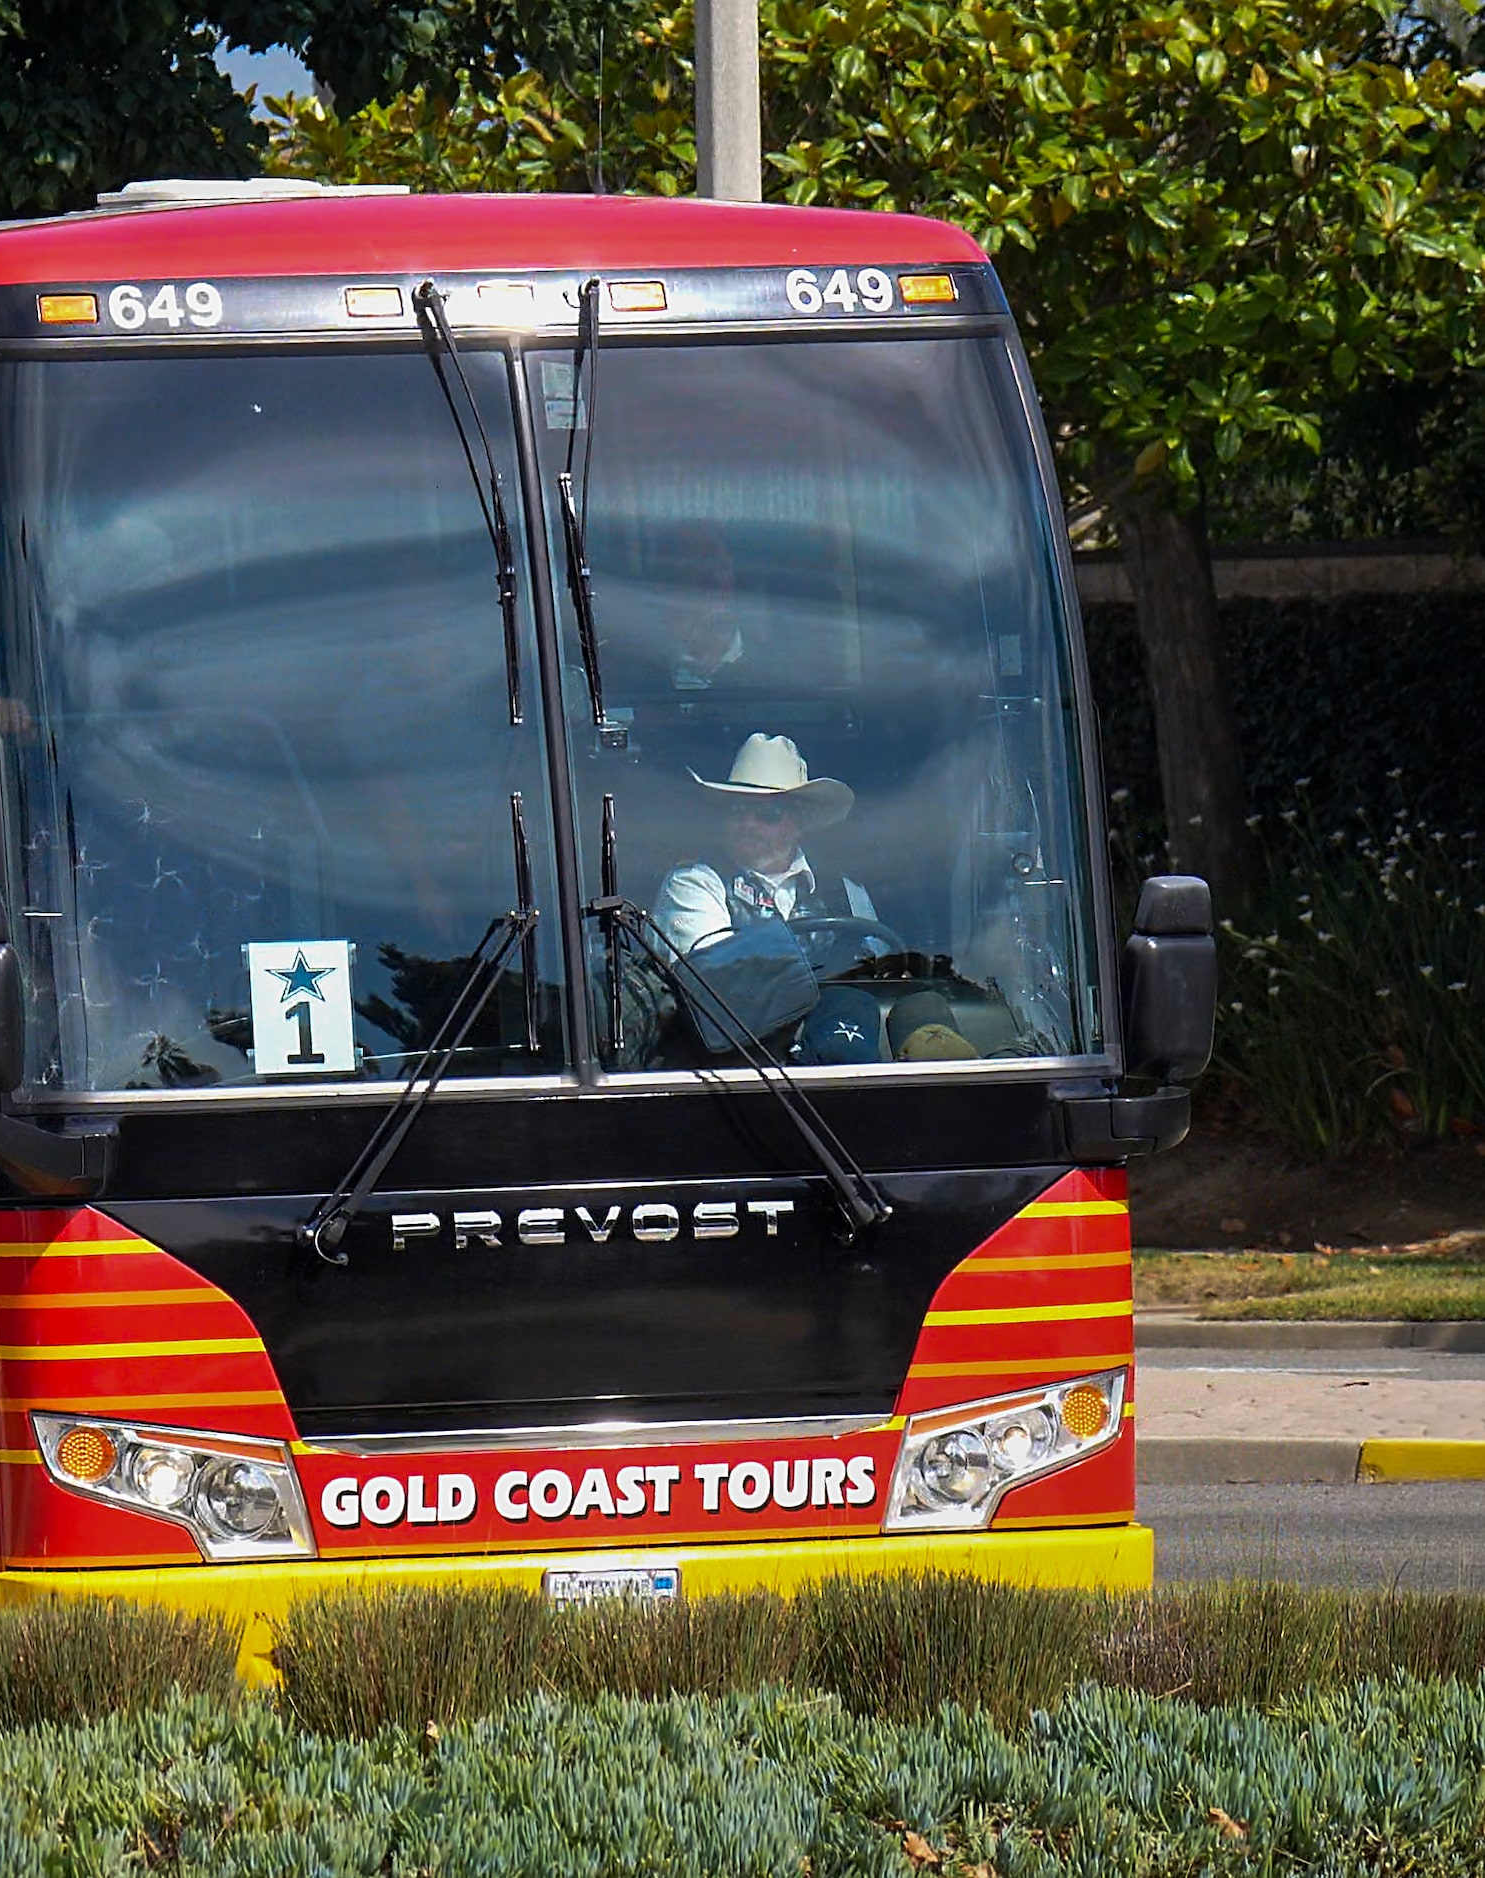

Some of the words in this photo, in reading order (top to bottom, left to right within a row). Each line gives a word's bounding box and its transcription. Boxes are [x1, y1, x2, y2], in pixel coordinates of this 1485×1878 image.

[110, 283, 223, 329] 649
[785, 269, 893, 313] 649
[285, 1001, 326, 1064] 1
[391, 1200, 795, 1251] PREVOST
[321, 1473, 476, 1526] GOLD
[494, 1465, 680, 1520] COAST
[694, 1455, 877, 1512] TOURS
